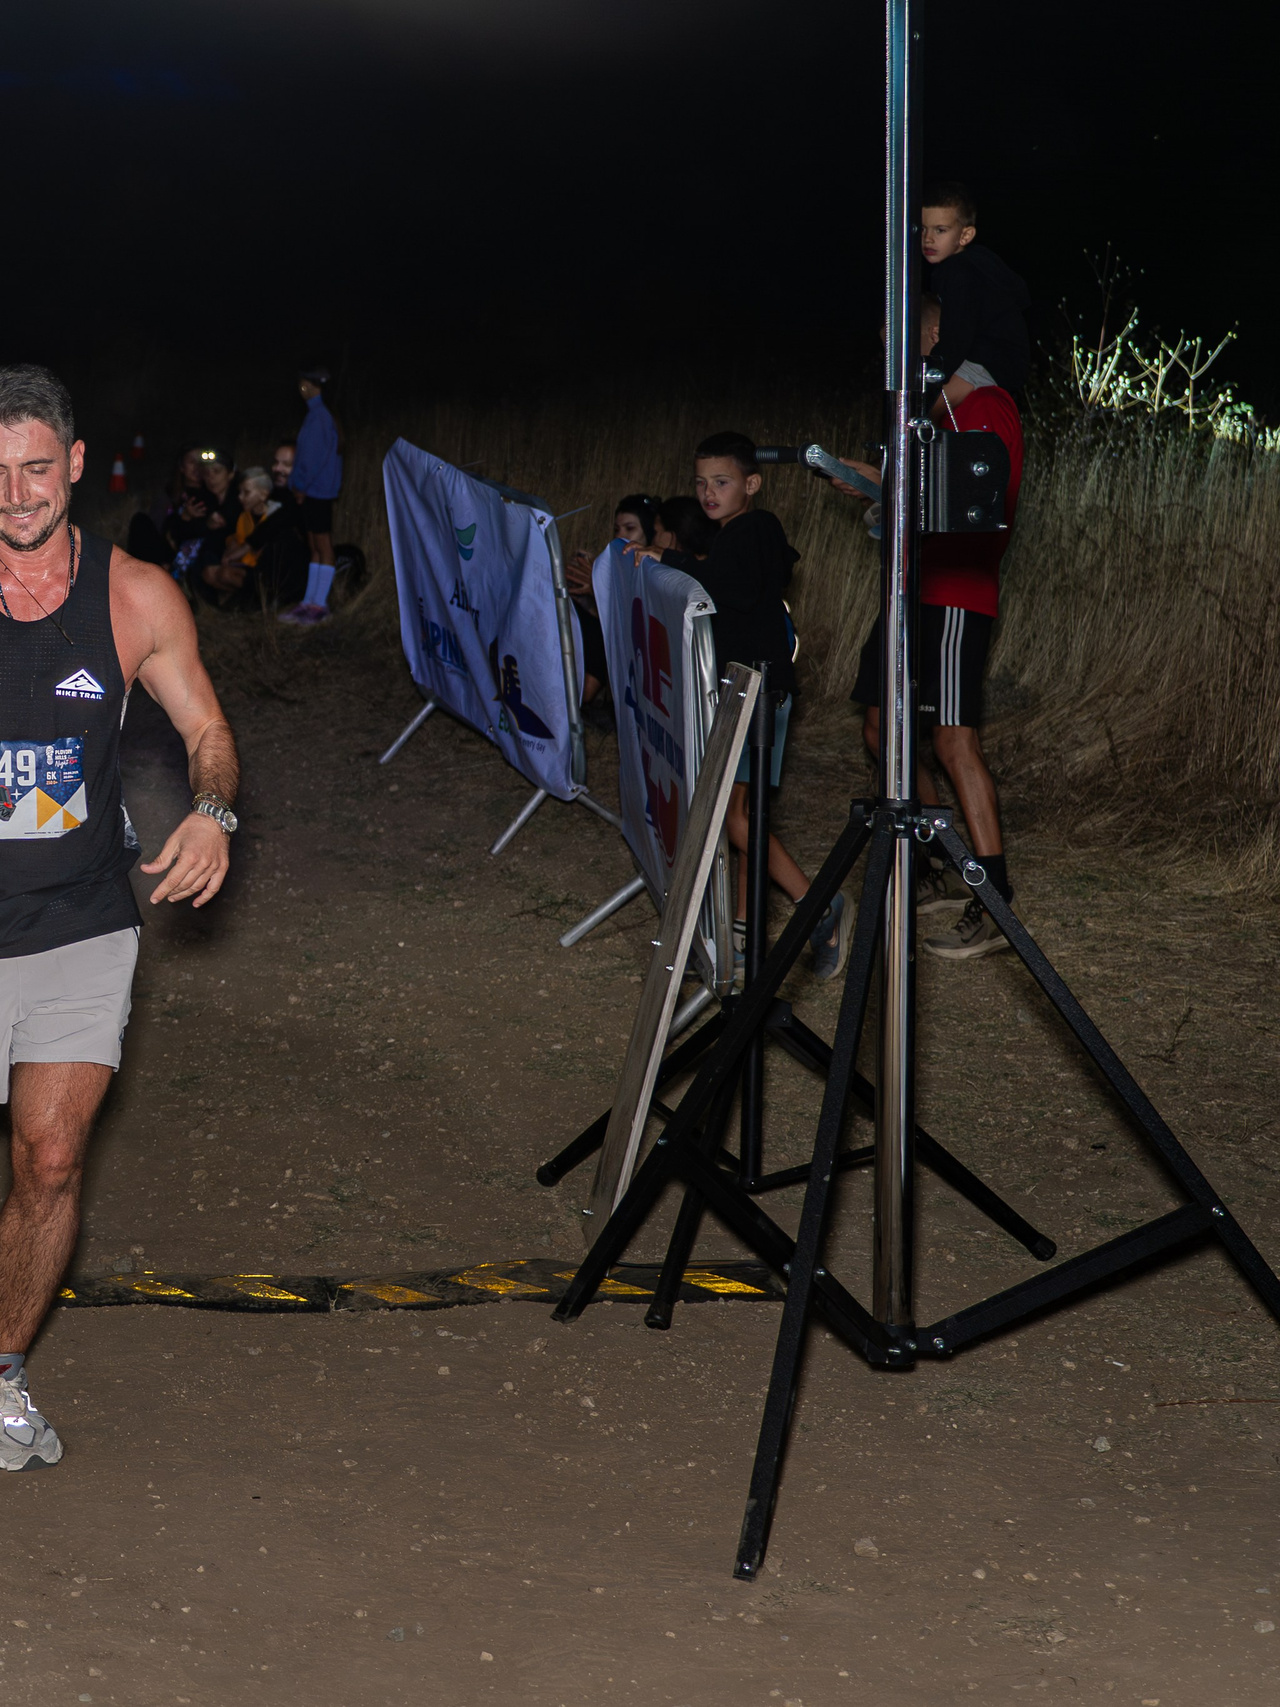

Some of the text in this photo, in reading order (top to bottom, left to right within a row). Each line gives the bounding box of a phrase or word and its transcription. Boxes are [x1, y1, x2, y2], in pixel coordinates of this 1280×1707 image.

[55, 689, 103, 700] NIKE TRAIL
[46, 771, 57, 780] 6K
